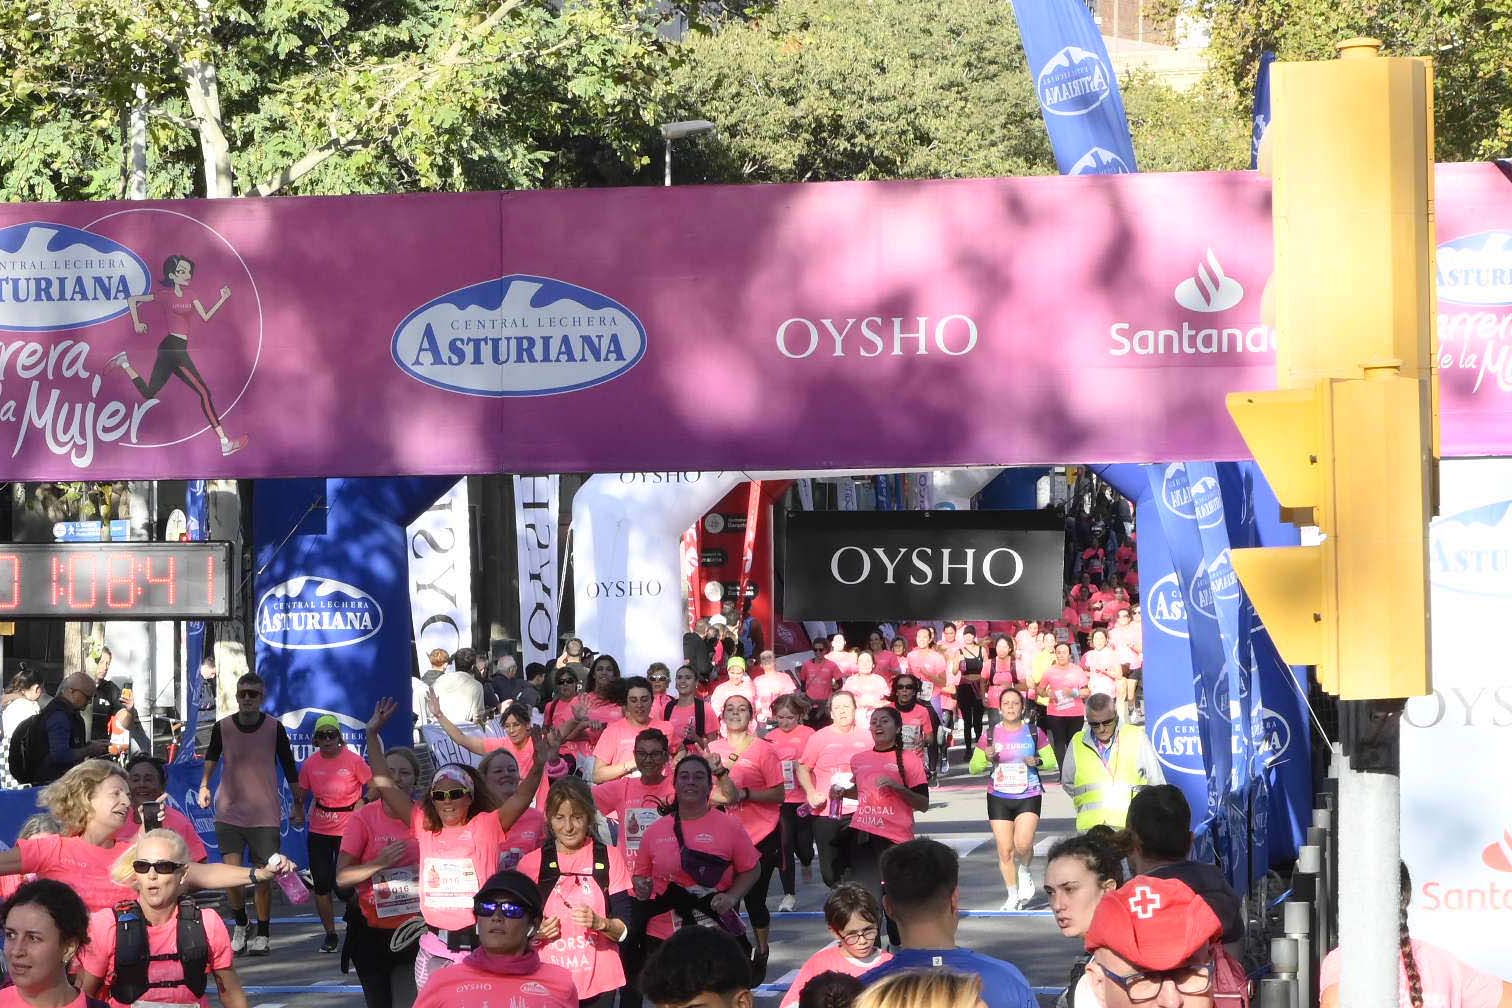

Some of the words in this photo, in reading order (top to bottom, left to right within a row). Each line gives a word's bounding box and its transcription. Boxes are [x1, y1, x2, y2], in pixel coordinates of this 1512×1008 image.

[55, 259, 126, 269] LECHERA
[451, 318, 528, 330] CENTRAL
[538, 315, 618, 327] LECHERA
[411, 322, 626, 366] ASTURIANA
[776, 315, 979, 358] OYSHO
[1459, 343, 1477, 369] la
[12, 377, 161, 467] Mujer
[830, 546, 1024, 587] OYSHO
[586, 579, 662, 600] OYSHO
[273, 602, 316, 610] CENTRAL
[320, 601, 369, 610] LECHERA
[261, 607, 374, 634] ASTURIANA
[392, 886, 409, 894] 016
[457, 983, 492, 993] OYSHO
